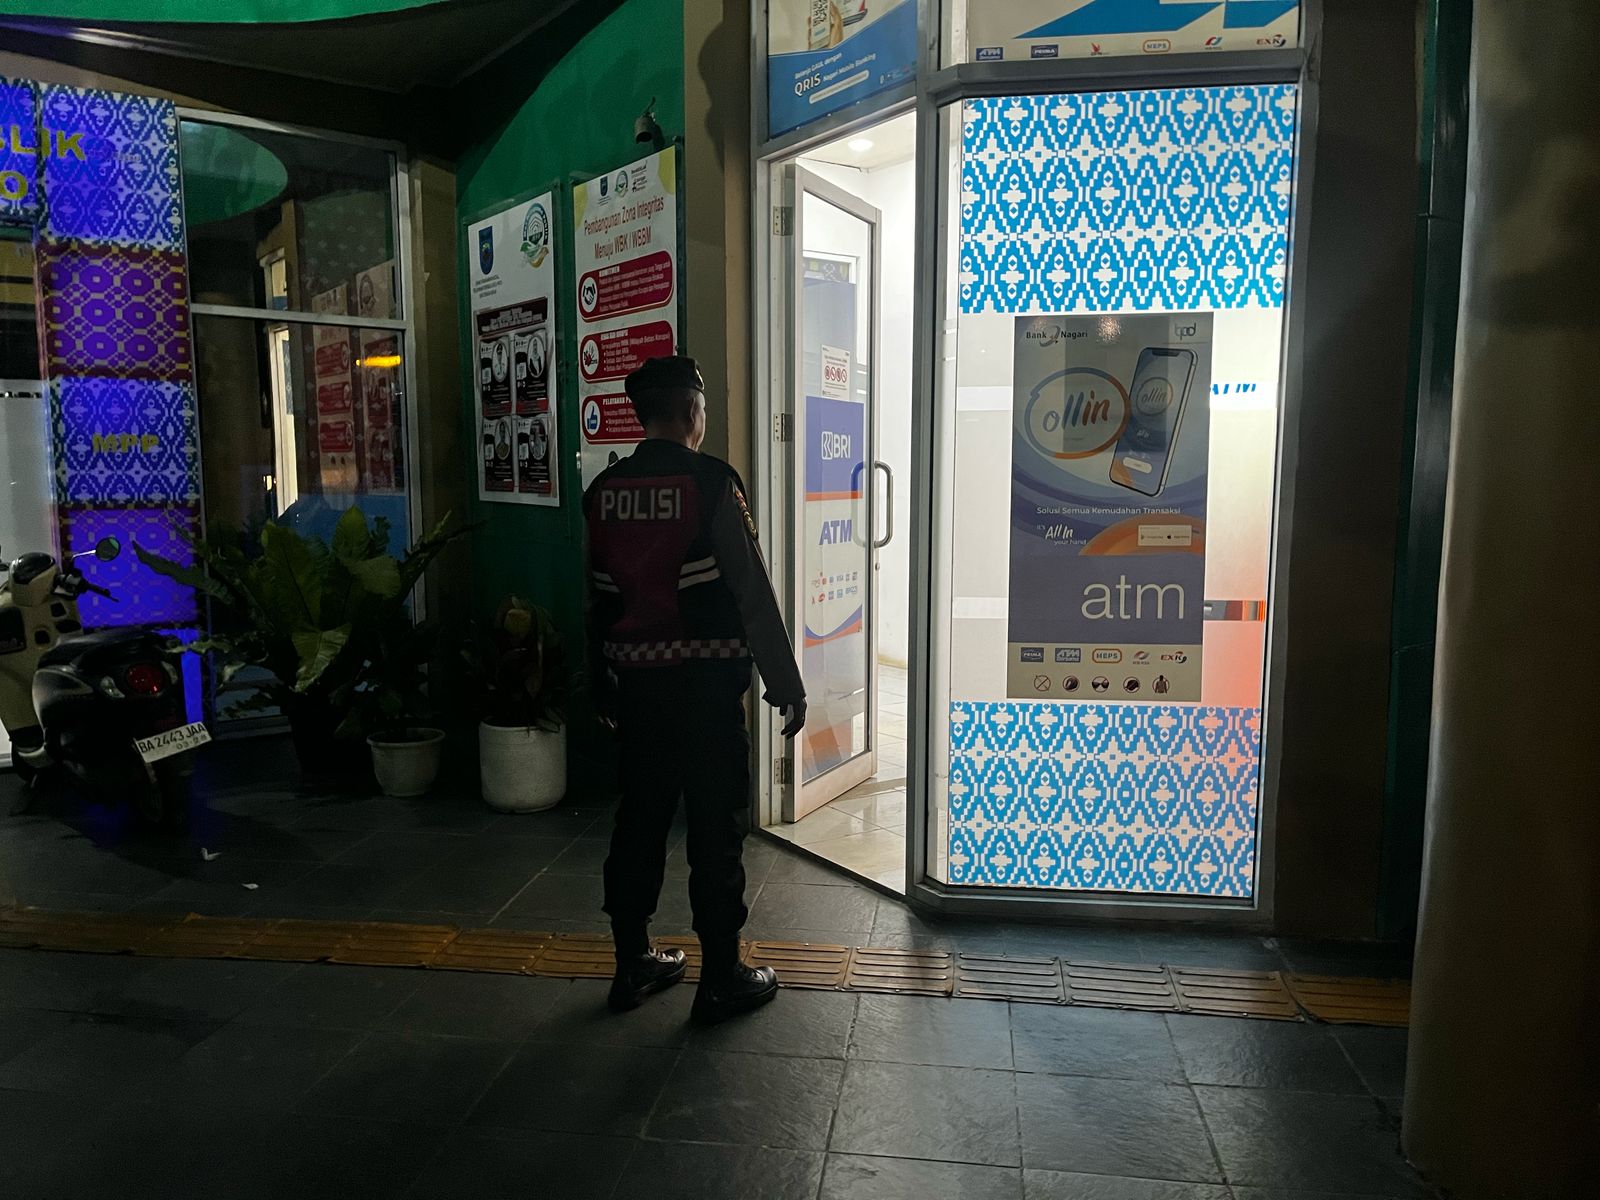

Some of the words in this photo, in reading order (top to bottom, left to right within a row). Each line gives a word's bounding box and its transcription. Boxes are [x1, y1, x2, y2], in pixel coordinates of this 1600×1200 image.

[794, 73, 821, 96] QRIS
[0, 124, 86, 161] LIK
[584, 213, 620, 236] Pembangunan
[621, 205, 636, 224] Zona
[637, 196, 664, 220] Integritas
[594, 240, 614, 260] Menuju
[614, 233, 628, 253] WBK
[632, 226, 652, 248] WBBM
[1025, 331, 1047, 339] Bank
[1060, 330, 1088, 340] Nagari
[1042, 390, 1110, 433] ollin
[92, 433, 160, 454] MPP
[833, 434, 851, 459] BRI
[600, 488, 681, 521] POLISI
[1036, 506, 1060, 515] Solusi
[1062, 507, 1090, 515] Semua
[1091, 506, 1141, 515] Kemudahan
[1142, 506, 1181, 515] Transaksi
[818, 519, 853, 546] ATM
[1081, 574, 1185, 620] atm
[138, 739, 155, 753] BA
[154, 730, 185, 748] 2443
[186, 723, 205, 737] JAA
